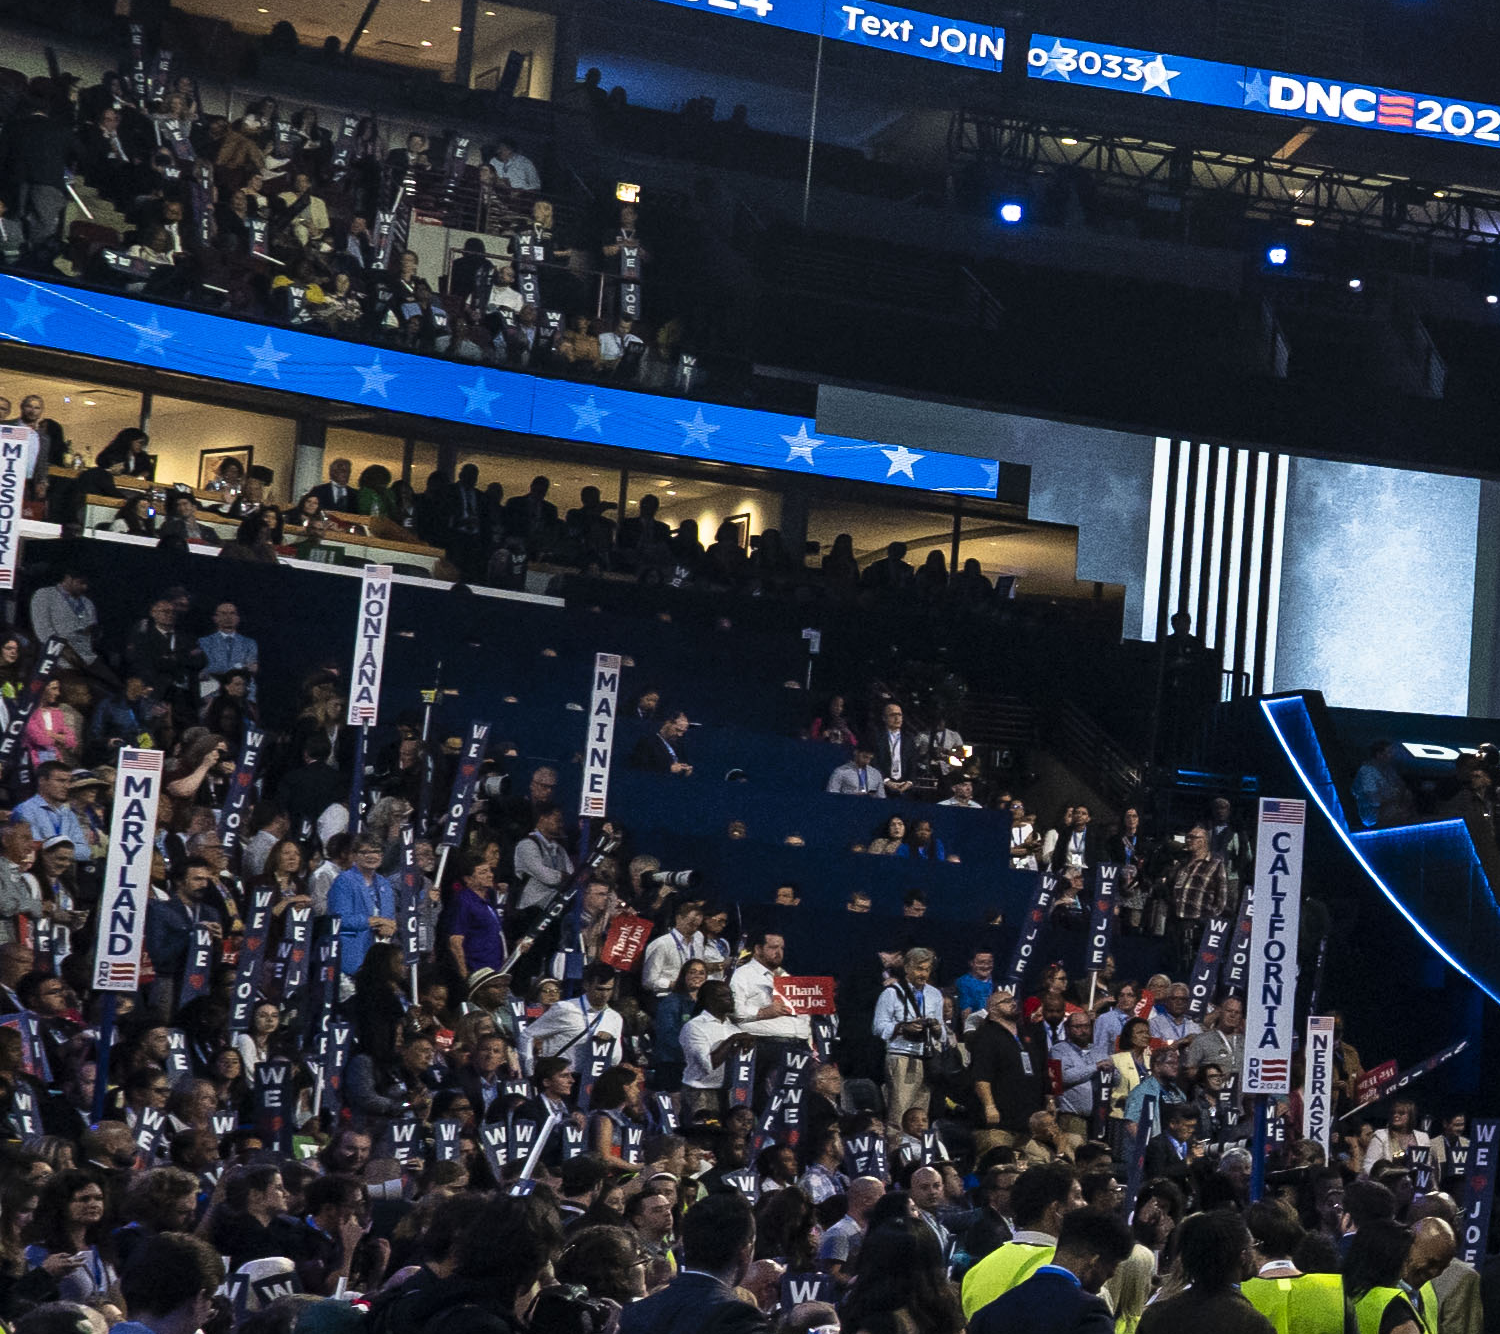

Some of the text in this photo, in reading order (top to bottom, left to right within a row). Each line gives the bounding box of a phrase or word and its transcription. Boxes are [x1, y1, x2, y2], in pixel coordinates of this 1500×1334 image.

[841, 5, 1167, 88] Text JOIN 30330
[1269, 75, 1377, 122] DNC
[519, 234, 535, 304] WE JOE
[625, 247, 638, 317] WE JOE
[355, 581, 387, 704] MONTANA
[468, 725, 489, 759] WE
[590, 672, 618, 794] MAINE
[223, 732, 264, 848] WE JOE
[106, 775, 151, 957] MARYLAND
[292, 907, 311, 942] WE
[610, 923, 634, 957] Thank
[1015, 875, 1058, 974] WE JOE
[1092, 865, 1117, 964] WE JOE
[1257, 831, 1292, 1050] CALIFORNIA
[234, 890, 272, 1020] WE JOE
[1189, 919, 1228, 1014] WE JOE
[783, 984, 823, 997] Thank
[807, 996, 826, 1009] Joe
[260, 1067, 287, 1108] WE
[592, 1041, 610, 1077] WE
[784, 1052, 809, 1085] WE
[1248, 1057, 1260, 1089] DNC
[1309, 1034, 1328, 1142] NEBRASK
[138, 1107, 165, 1151] WE
[392, 1124, 417, 1164] WE
[484, 1127, 507, 1165] WE
[848, 1136, 869, 1173] WE
[1463, 1124, 1496, 1267] WE JOE
